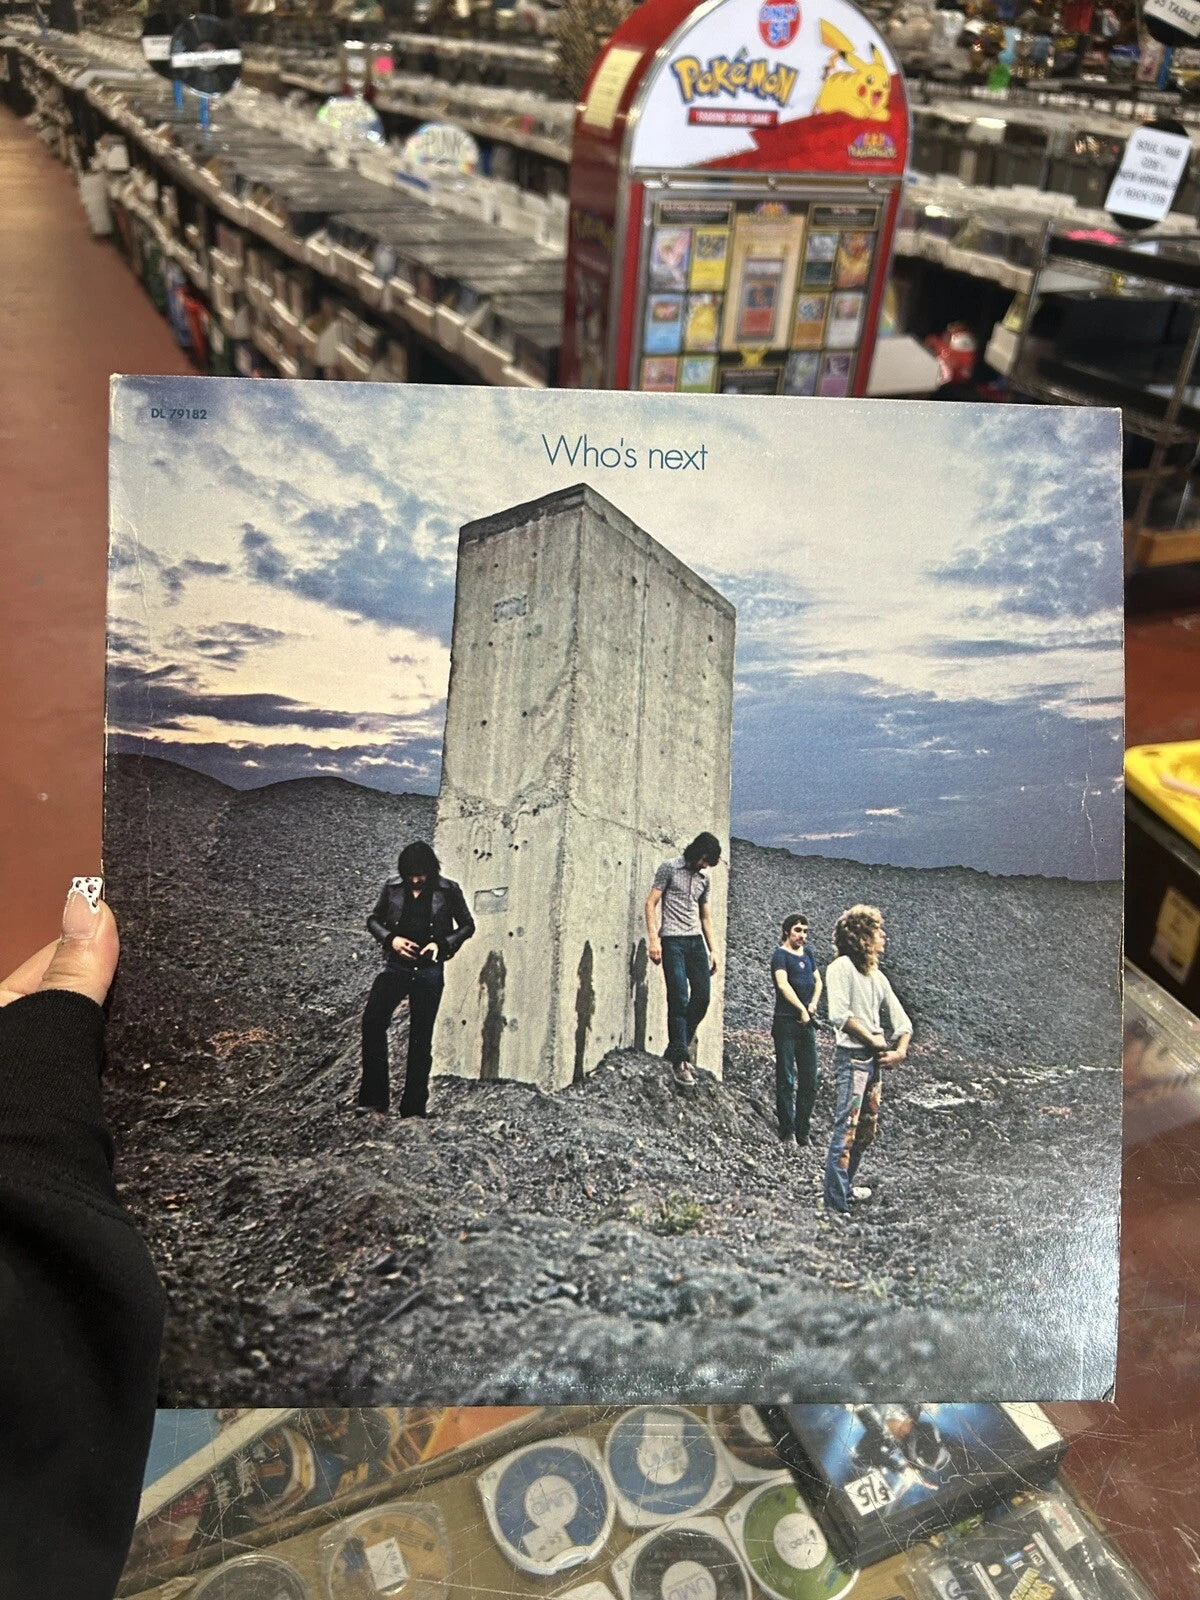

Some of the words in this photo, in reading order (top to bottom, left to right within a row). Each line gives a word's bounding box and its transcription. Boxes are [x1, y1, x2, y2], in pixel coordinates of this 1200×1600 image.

[759, 5, 799, 20] ONLY
[1169, 1, 1199, 26] TABLE
[771, 20, 790, 41] $1
[151, 408, 166, 419] DL
[169, 408, 207, 420] 79182
[541, 433, 638, 469] Who's
[649, 444, 709, 471] next
